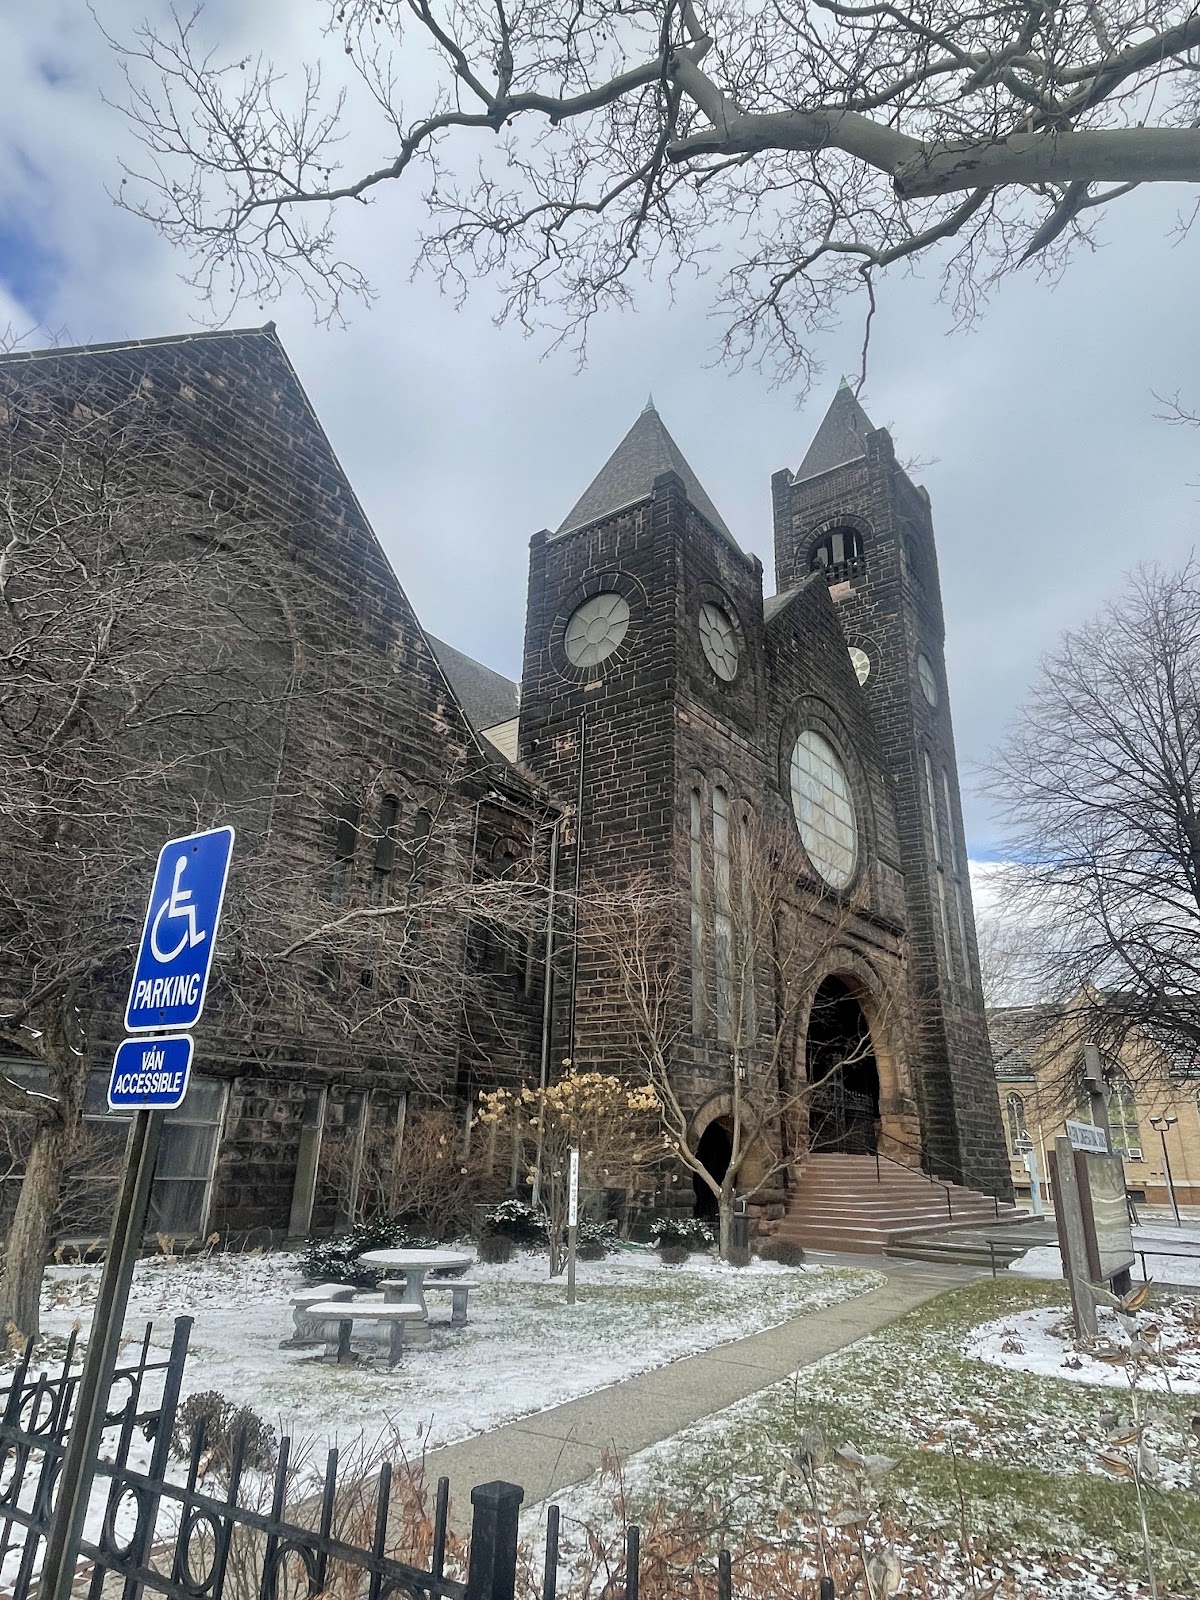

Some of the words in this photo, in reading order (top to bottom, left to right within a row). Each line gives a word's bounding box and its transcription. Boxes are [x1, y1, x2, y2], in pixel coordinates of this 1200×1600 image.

[133, 973, 200, 1010] PARKING
[141, 1051, 165, 1071] VAN
[114, 1072, 183, 1094] ACCESSIBLE
